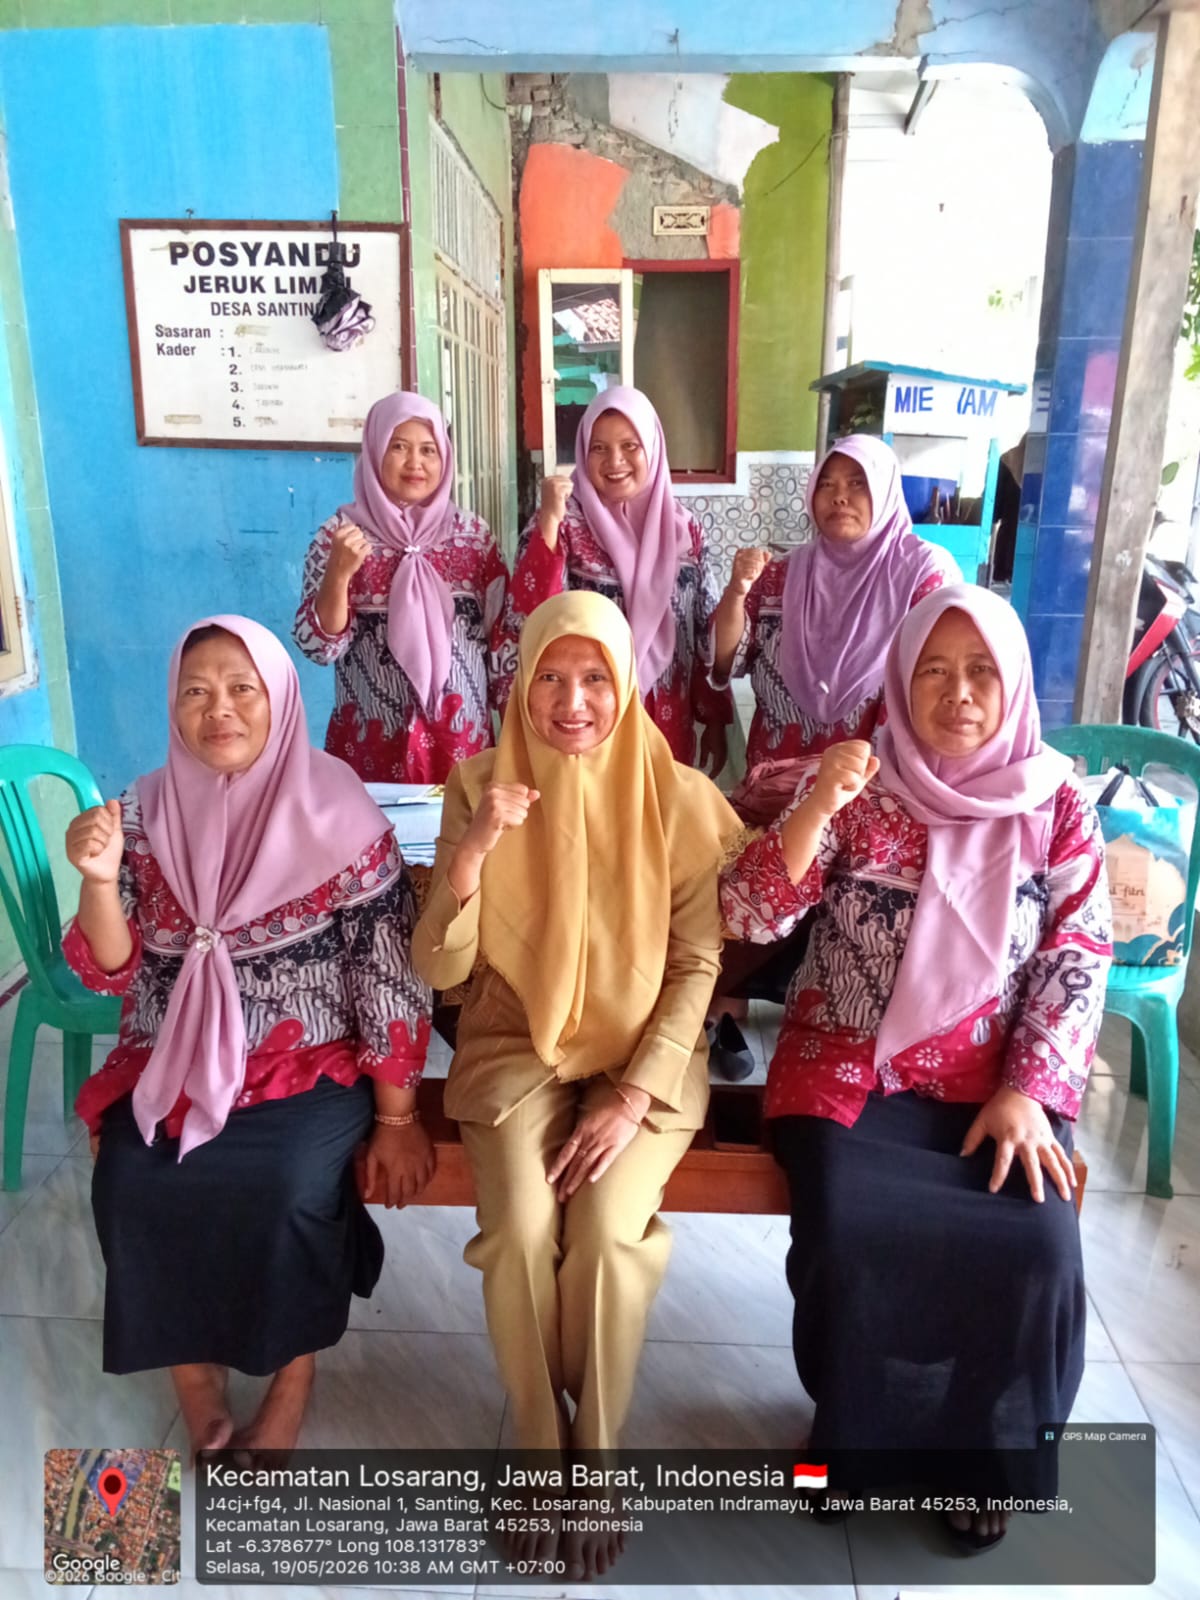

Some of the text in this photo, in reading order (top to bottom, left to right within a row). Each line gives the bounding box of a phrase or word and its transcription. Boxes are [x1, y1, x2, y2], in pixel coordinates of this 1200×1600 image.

[184, 275, 351, 294] JERUK LIM
[210, 302, 252, 317] DESA
[155, 324, 211, 338] Sasaran
[157, 343, 196, 356] Kader
[229, 363, 242, 376] 2.
[230, 381, 244, 393] 3.
[232, 399, 245, 411] 4.
[894, 386, 934, 413] MIE
[233, 416, 246, 428] 5.
